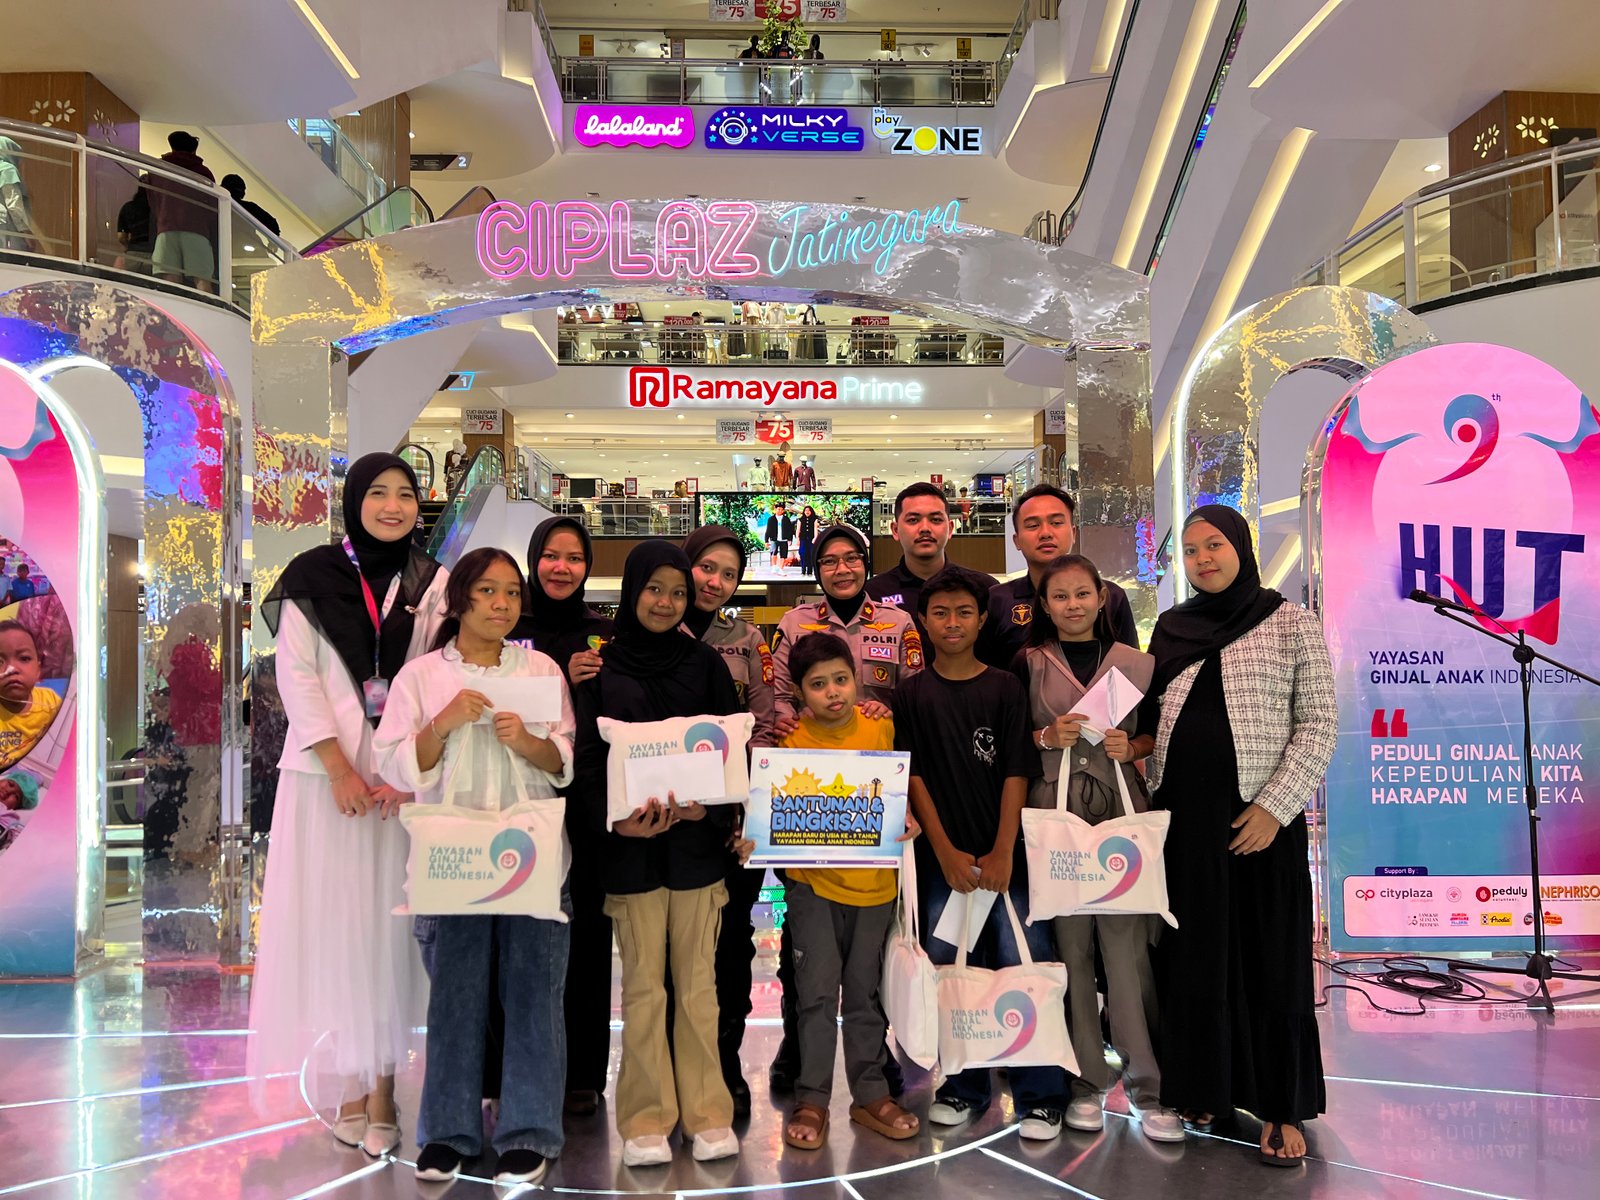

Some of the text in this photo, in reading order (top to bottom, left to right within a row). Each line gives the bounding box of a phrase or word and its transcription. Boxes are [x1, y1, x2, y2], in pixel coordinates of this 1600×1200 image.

[729, 6, 745, 18] 75
[820, 7, 836, 19] 75
[583, 115, 683, 136] lalaland
[761, 113, 844, 127] MILKY
[874, 114, 900, 126] play
[761, 131, 860, 143] VERSE
[893, 127, 980, 151] ZONE
[458, 156, 467, 167] 2
[476, 199, 964, 280] CIPLAZ Jatinegara
[460, 376, 467, 387] 1
[673, 374, 923, 405] Ramayana Prime
[478, 420, 493, 431] 75
[767, 421, 791, 438] 75
[732, 432, 746, 441] 75
[810, 431, 824, 441] 75
[1398, 521, 1586, 620] HUT
[863, 635, 897, 645] POLRI
[870, 647, 891, 656] DVI
[1369, 650, 1445, 665] YAYASAN
[1370, 669, 1431, 684] GINJAL
[1436, 669, 1485, 684] ANAK
[628, 741, 678, 753] YAYASAN
[1370, 743, 1583, 761] PEDULI GINJAL ANAK
[1371, 765, 1584, 783] KEPEDULIAN KITA
[1371, 787, 1467, 804] HARAPAN
[772, 795, 884, 813] SANTUNAN &
[771, 811, 882, 831] BINGKISAN
[429, 846, 483, 856] YAYASAN
[1049, 850, 1091, 859] YAYASAN
[428, 854, 473, 864] GINJAL
[1049, 857, 1084, 867] GINJAL
[428, 863, 461, 871] ANAK
[1050, 865, 1077, 873] ANAK
[1384, 867, 1407, 875] Support
[428, 870, 495, 880] INDONESIA
[1050, 872, 1106, 882] INDONESIA
[1379, 887, 1433, 900] cityplaza
[1492, 886, 1528, 898] peduly
[950, 1008, 988, 1017] YAYASAN
[952, 1024, 975, 1033] ANAK
[952, 1030, 1004, 1040] INDONESIA
